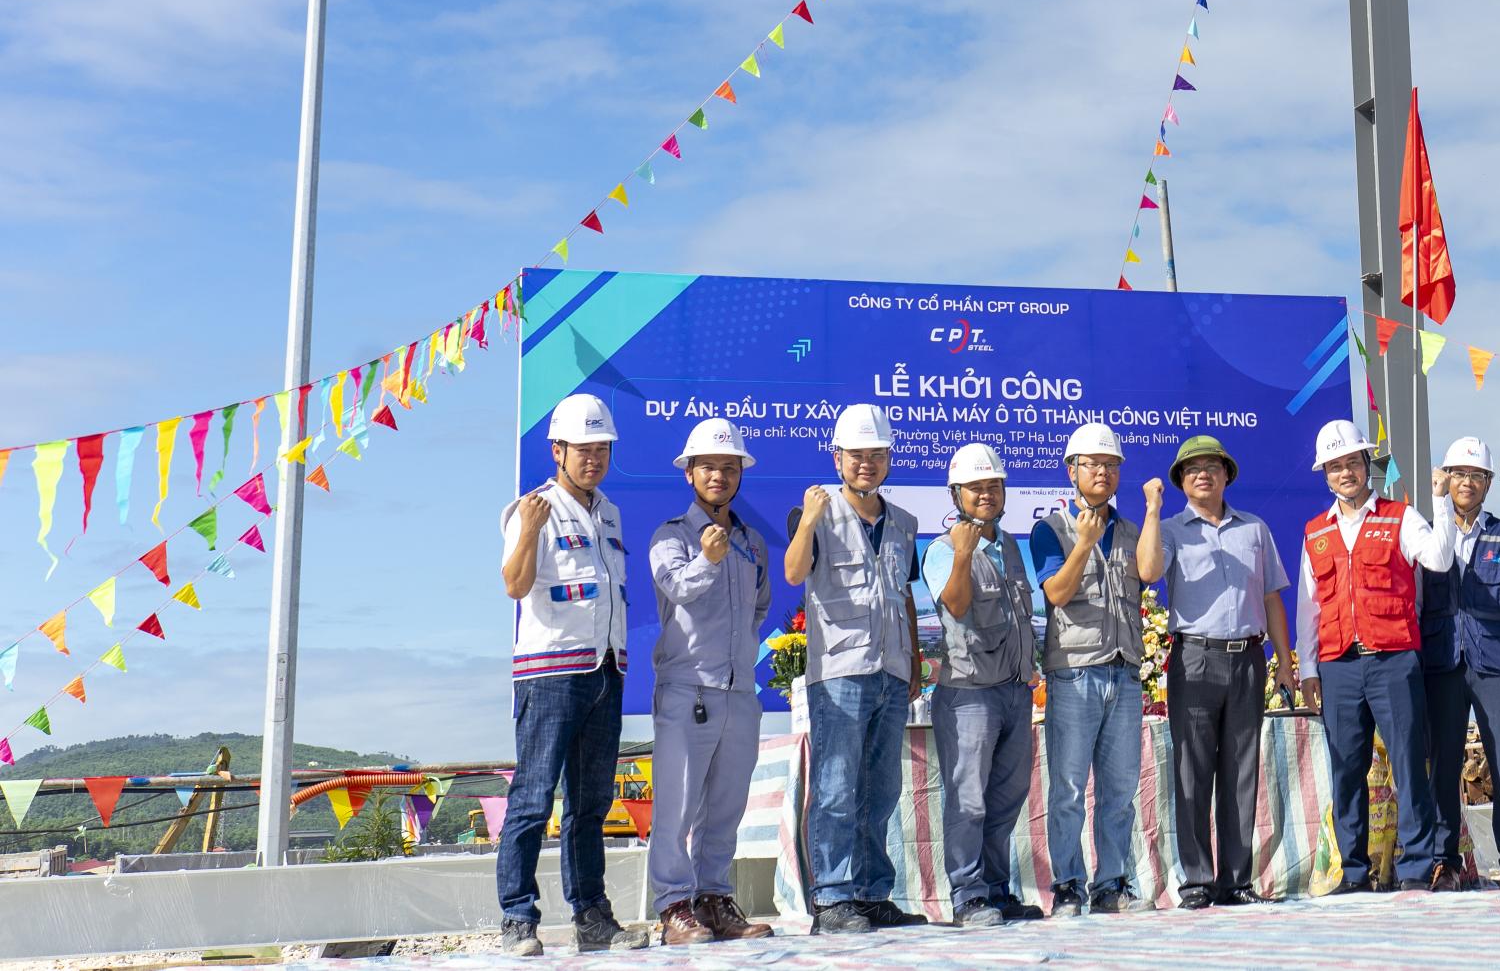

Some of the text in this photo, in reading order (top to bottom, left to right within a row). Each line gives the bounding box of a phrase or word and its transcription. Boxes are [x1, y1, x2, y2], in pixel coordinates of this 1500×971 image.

[849, 293, 1069, 315] CÔNG TY CỔ PHẦN CPT GROUP
[967, 344, 994, 352] STEEL
[874, 362, 1083, 401] LỄ KHỞI CÔNG
[645, 400, 679, 421] DỰ
[684, 397, 719, 417] ÁN:
[725, 395, 767, 419] ĐẦU
[771, 402, 801, 419] TƯ
[805, 399, 842, 420] XÂY
[908, 402, 948, 421] NHÀ
[953, 403, 990, 423] MÁY
[995, 404, 1009, 423] Ô
[1013, 404, 1037, 424] TÔ
[1042, 405, 1104, 425] THÀNH
[1109, 406, 1160, 426] CÔNG
[1164, 407, 1201, 430] VIỆT
[1206, 412, 1257, 427] HƯNG
[739, 425, 763, 438] Địa
[764, 426, 787, 439] chỉ:
[790, 426, 818, 438] KCN
[891, 429, 939, 443] Phường
[942, 430, 967, 442] Việt
[970, 431, 1007, 444] Hưng,
[1009, 431, 1025, 442] TP
[1028, 432, 1045, 444] Hạ
[1048, 432, 1071, 443] Lon
[1153, 433, 1179, 444] Ninh
[889, 441, 929, 455] Xưởng
[932, 444, 957, 454] Sơn
[1004, 444, 1034, 457] hạng
[1037, 447, 1063, 458] mục
[890, 457, 919, 469] Long,
[921, 459, 948, 470] ngày
[1008, 459, 1031, 469] năm
[1032, 459, 1059, 469] 2023
